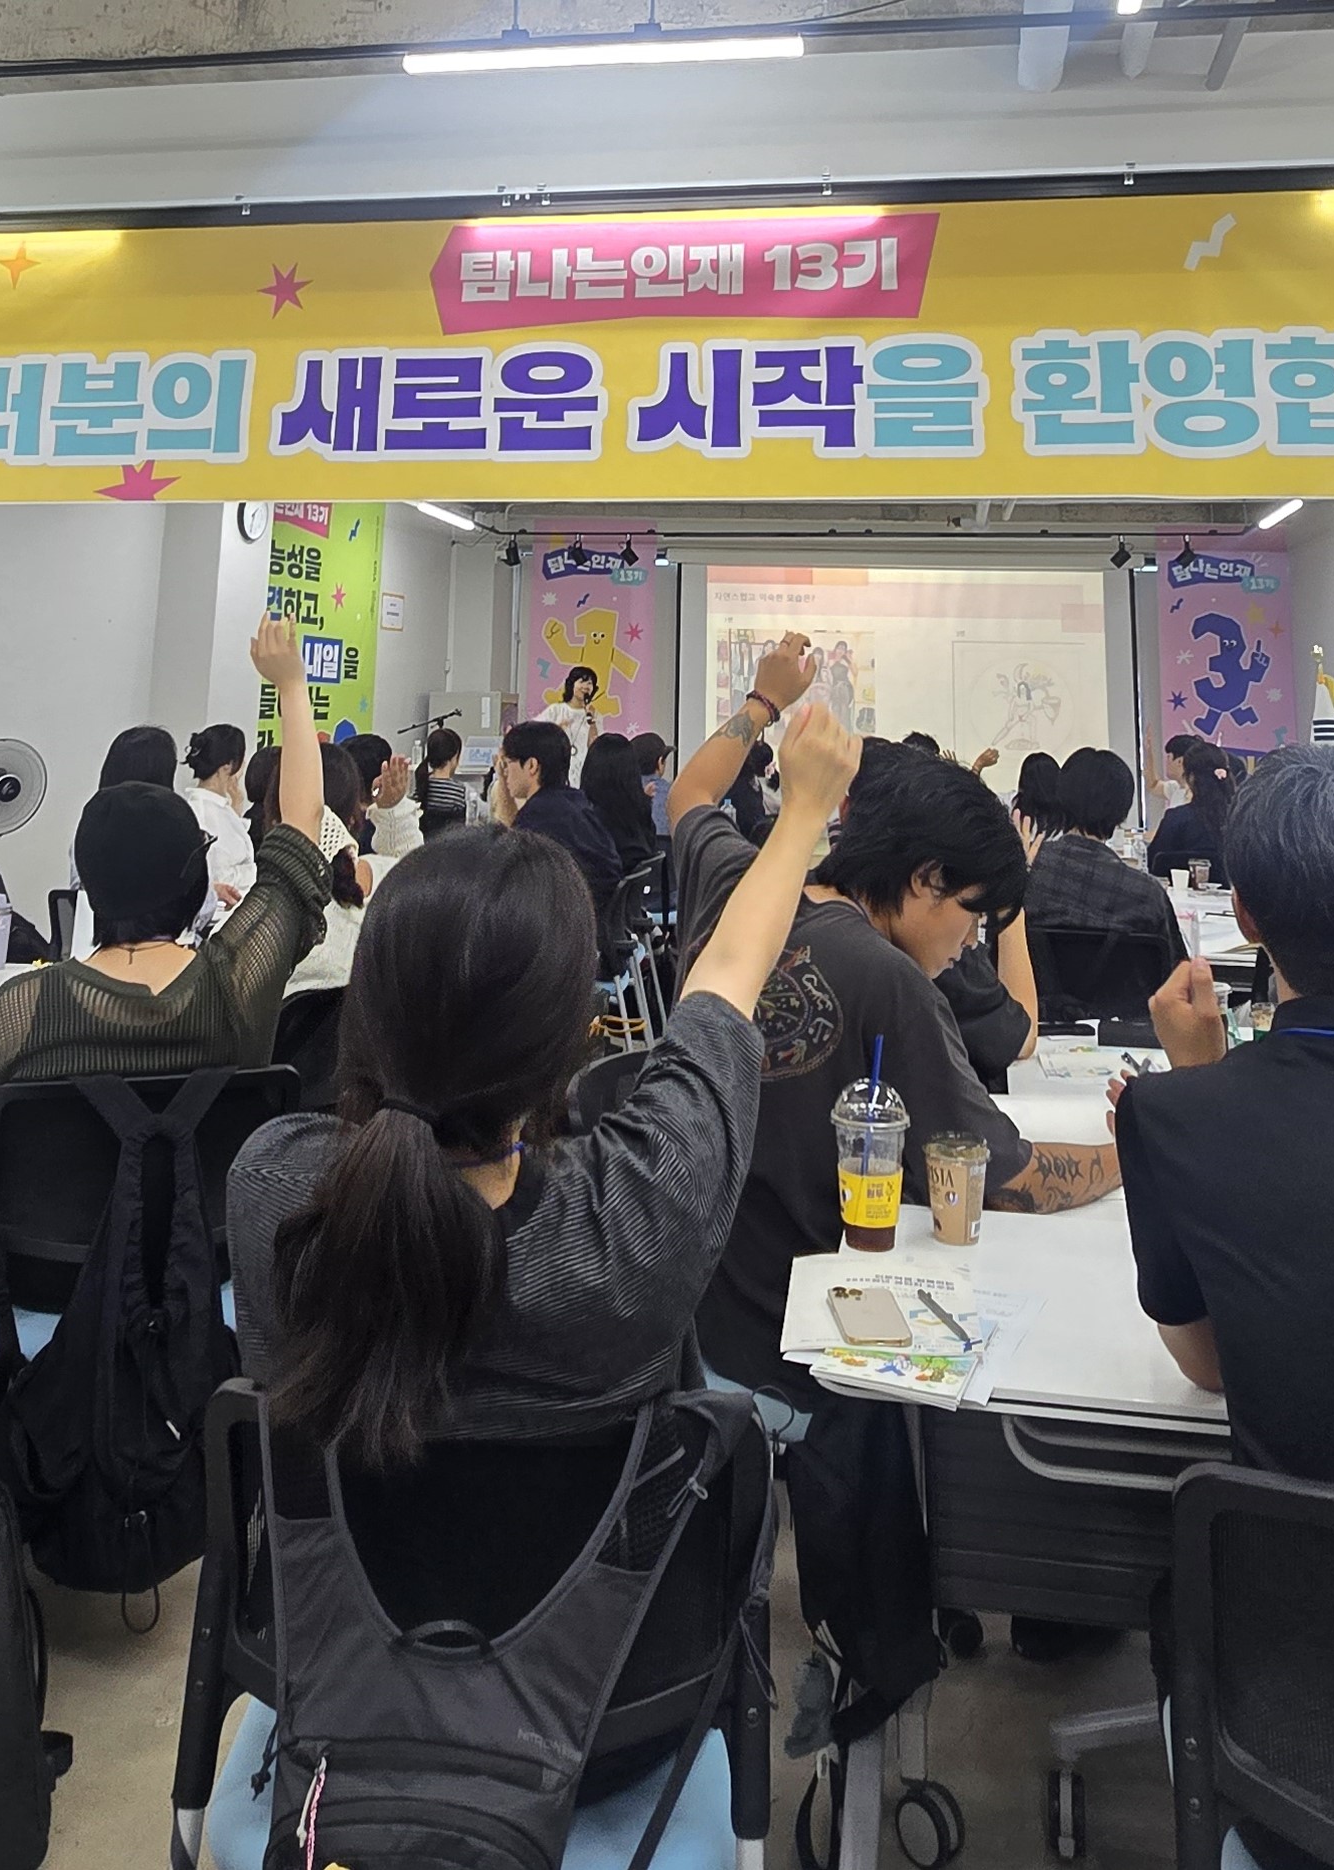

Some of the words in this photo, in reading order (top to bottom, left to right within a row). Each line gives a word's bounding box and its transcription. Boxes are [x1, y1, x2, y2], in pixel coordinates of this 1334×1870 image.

[460, 243, 745, 302] 탐나는인재
[764, 237, 899, 291] 13기
[279, 351, 599, 451] 새로운
[637, 344, 976, 447] 시작을
[306, 503, 329, 526] 13기
[269, 539, 322, 583] 능성을
[619, 569, 643, 582] 13기
